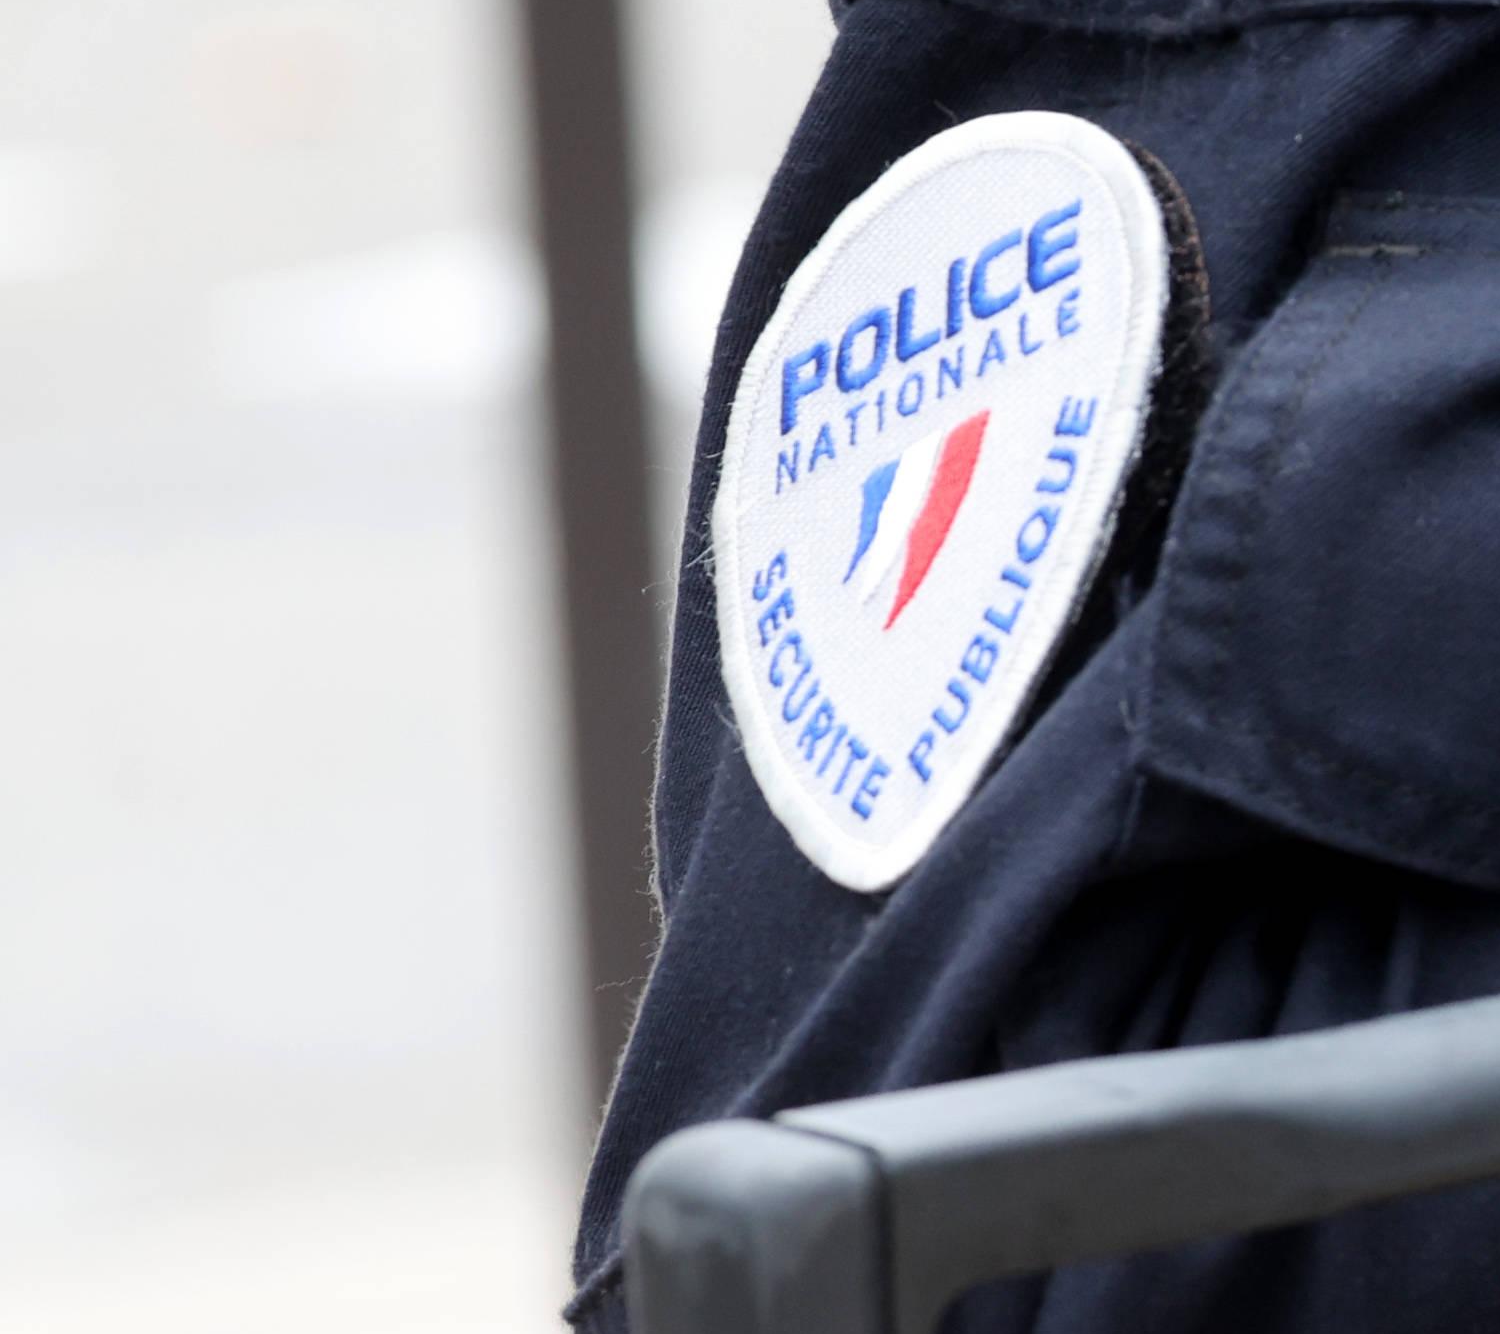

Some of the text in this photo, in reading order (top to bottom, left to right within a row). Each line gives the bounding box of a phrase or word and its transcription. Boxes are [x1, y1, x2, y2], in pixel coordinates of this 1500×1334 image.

[774, 287, 1082, 495] NATIONALE
[777, 198, 1085, 436] POLICE
[751, 394, 1099, 822] SECURITE PUBLIQUE
